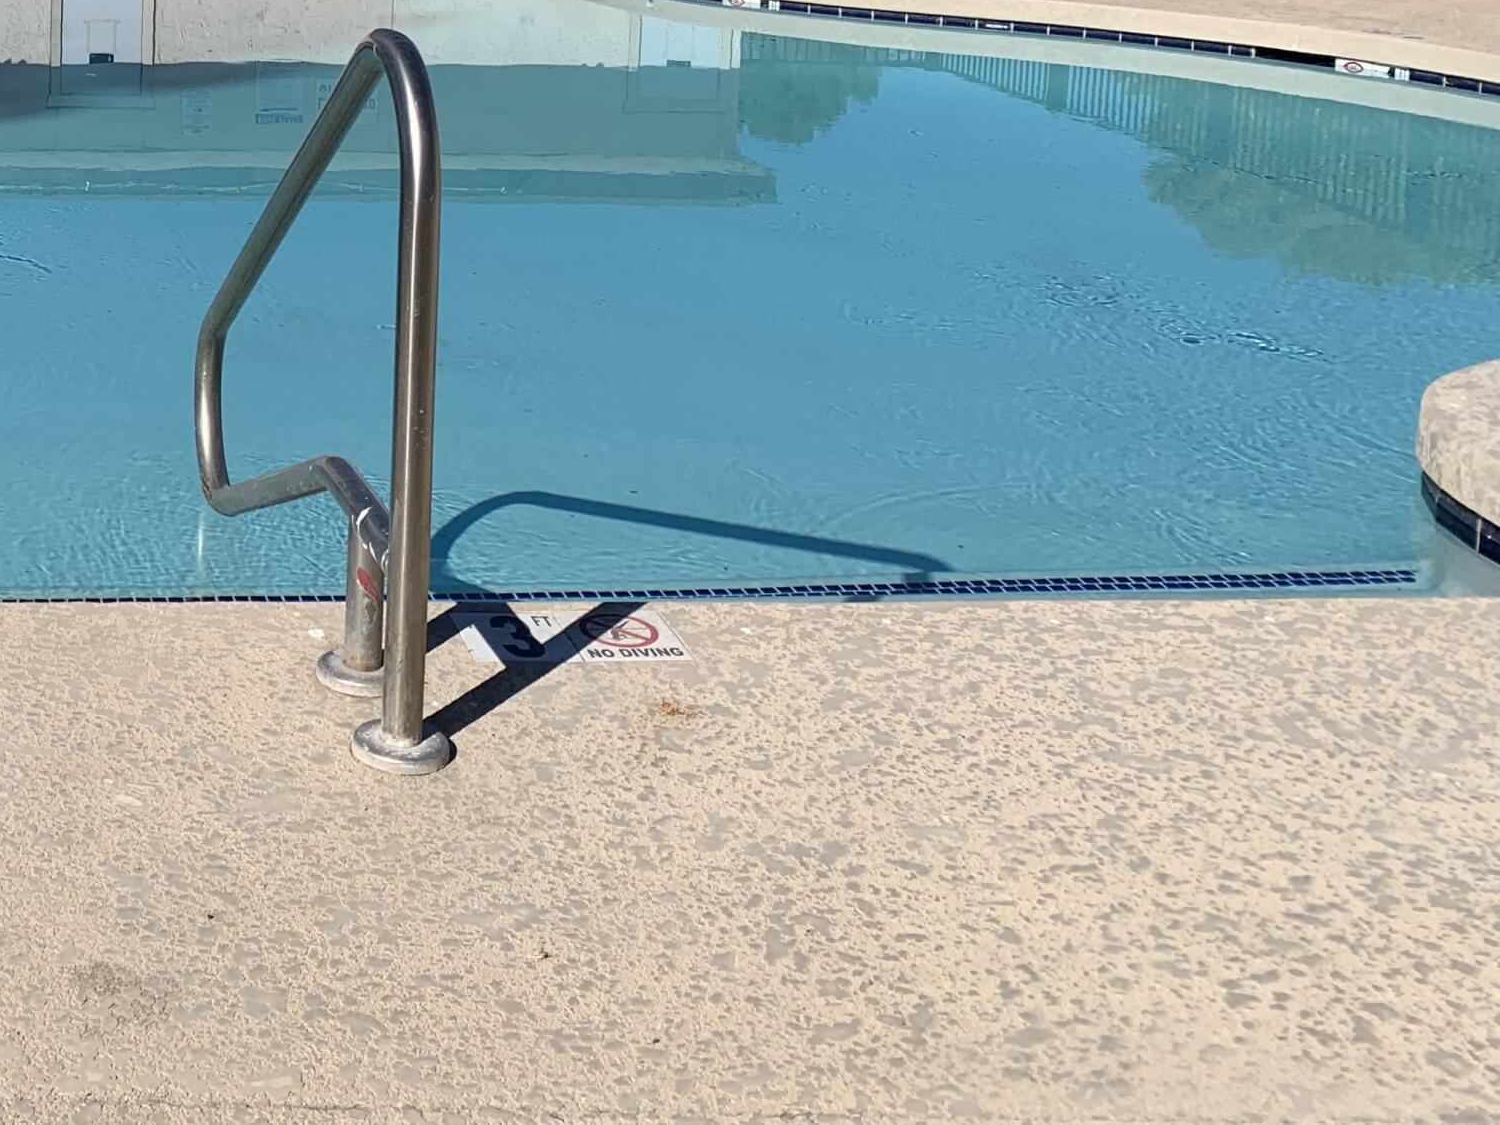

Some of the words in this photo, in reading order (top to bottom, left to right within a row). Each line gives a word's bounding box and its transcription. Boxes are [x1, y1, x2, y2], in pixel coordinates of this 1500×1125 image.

[489, 615, 546, 658] 3
[530, 615, 553, 627] FT
[587, 648, 616, 659] NO
[621, 647, 685, 658] DIVING
